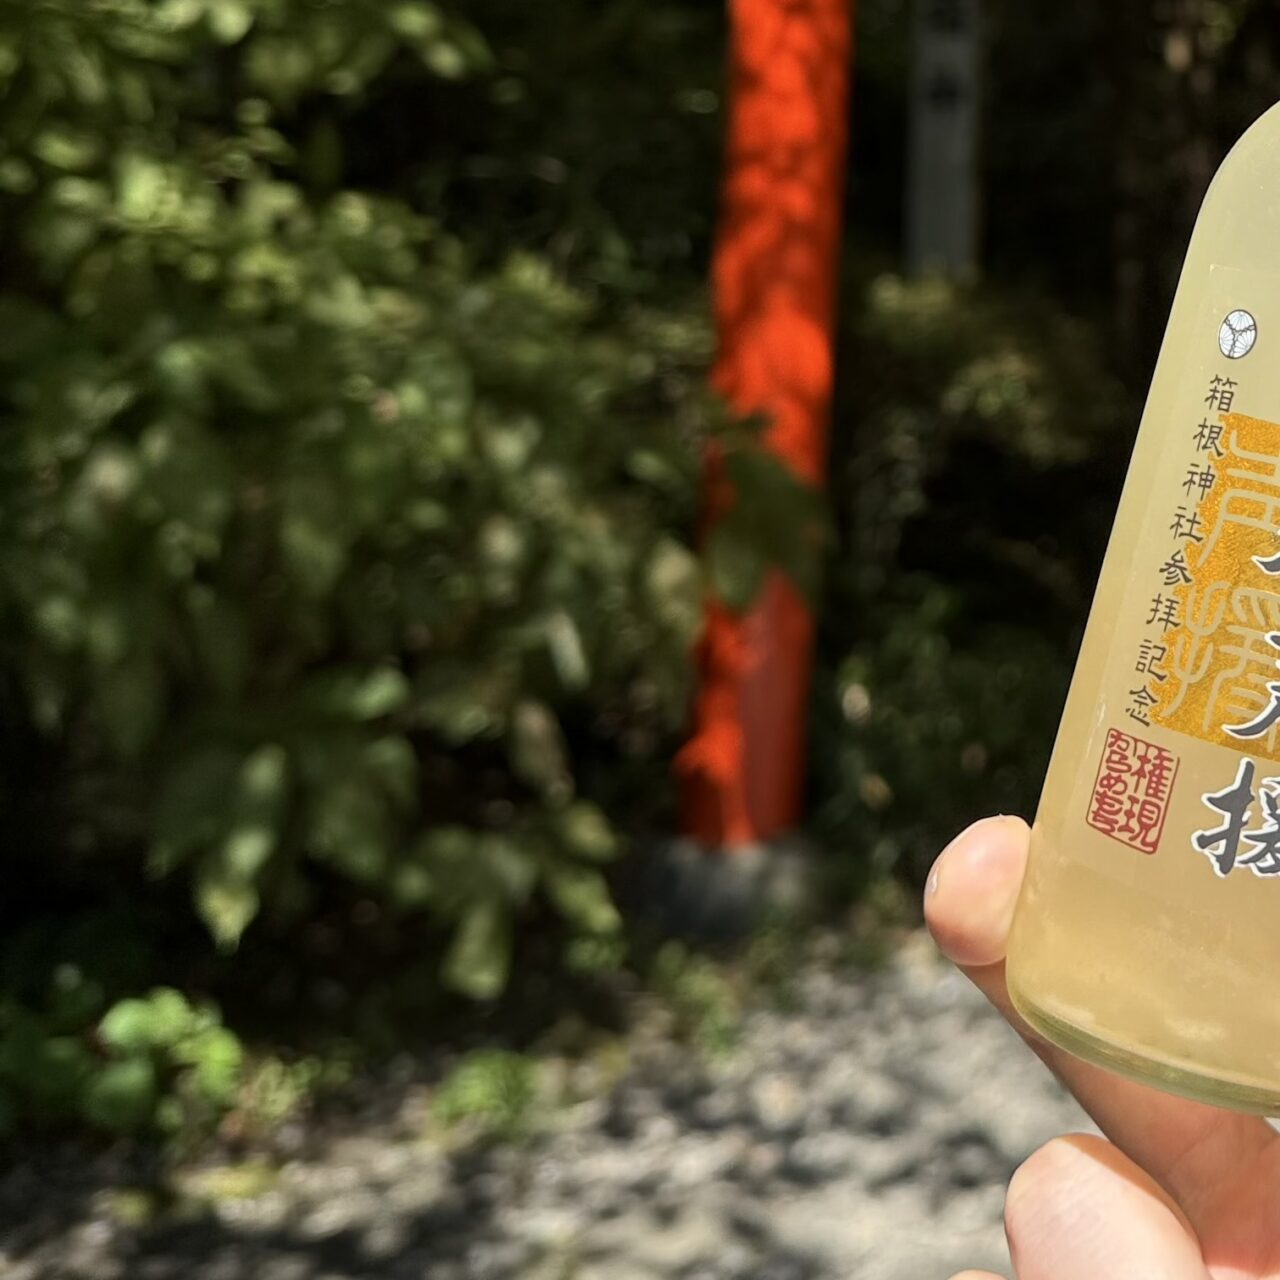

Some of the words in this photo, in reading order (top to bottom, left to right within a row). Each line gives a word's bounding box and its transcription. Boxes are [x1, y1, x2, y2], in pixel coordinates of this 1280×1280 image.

[1125, 373, 1238, 727] 箱根神社参拝記念
